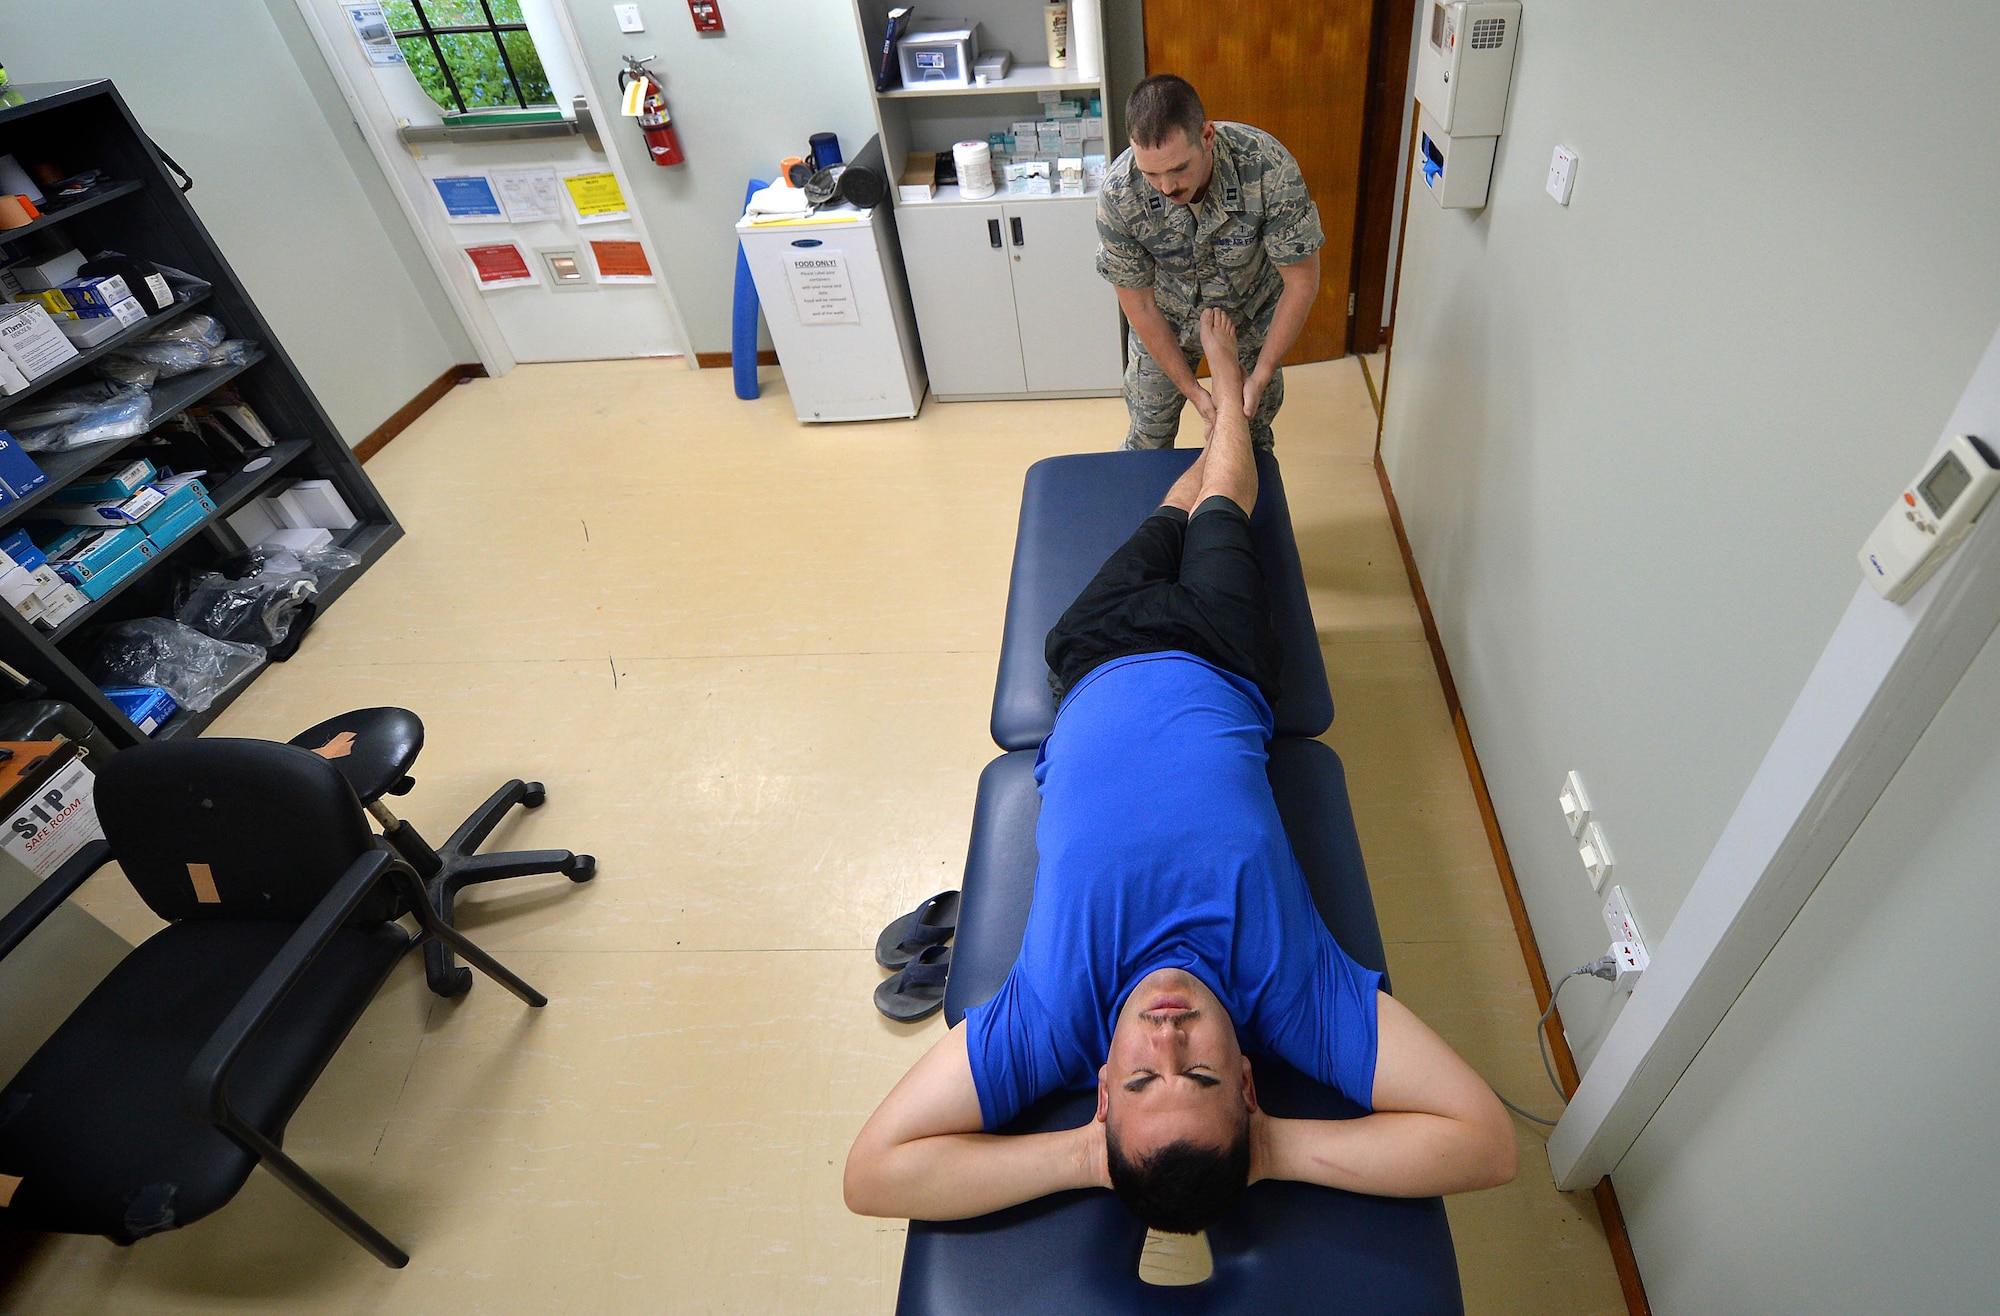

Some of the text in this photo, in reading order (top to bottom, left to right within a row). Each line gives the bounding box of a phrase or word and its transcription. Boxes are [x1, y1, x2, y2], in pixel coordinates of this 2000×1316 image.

[12, 789, 64, 839] SIP
[25, 797, 81, 851] SAFE ROOM
